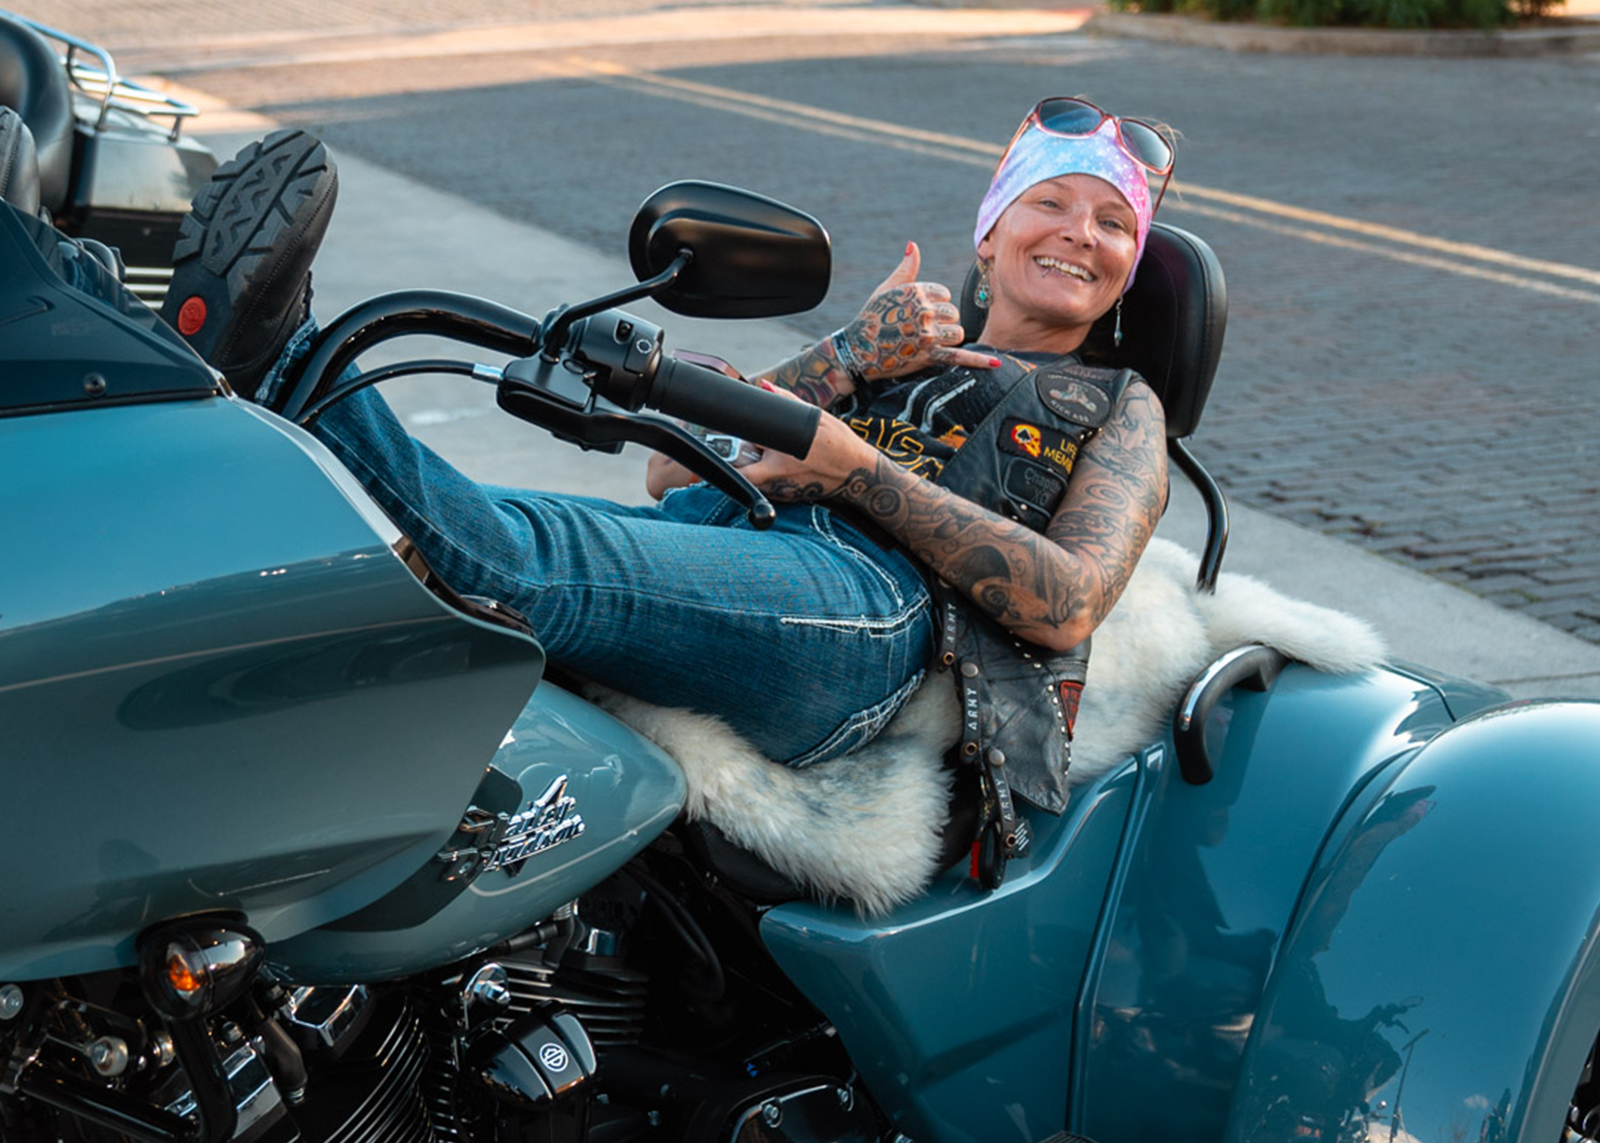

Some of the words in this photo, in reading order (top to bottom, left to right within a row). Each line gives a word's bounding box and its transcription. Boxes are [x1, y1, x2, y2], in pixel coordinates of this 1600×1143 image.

[947, 603, 956, 643] ARMY
[967, 687, 978, 731] ARMY
[996, 779, 1012, 821] ARMY
